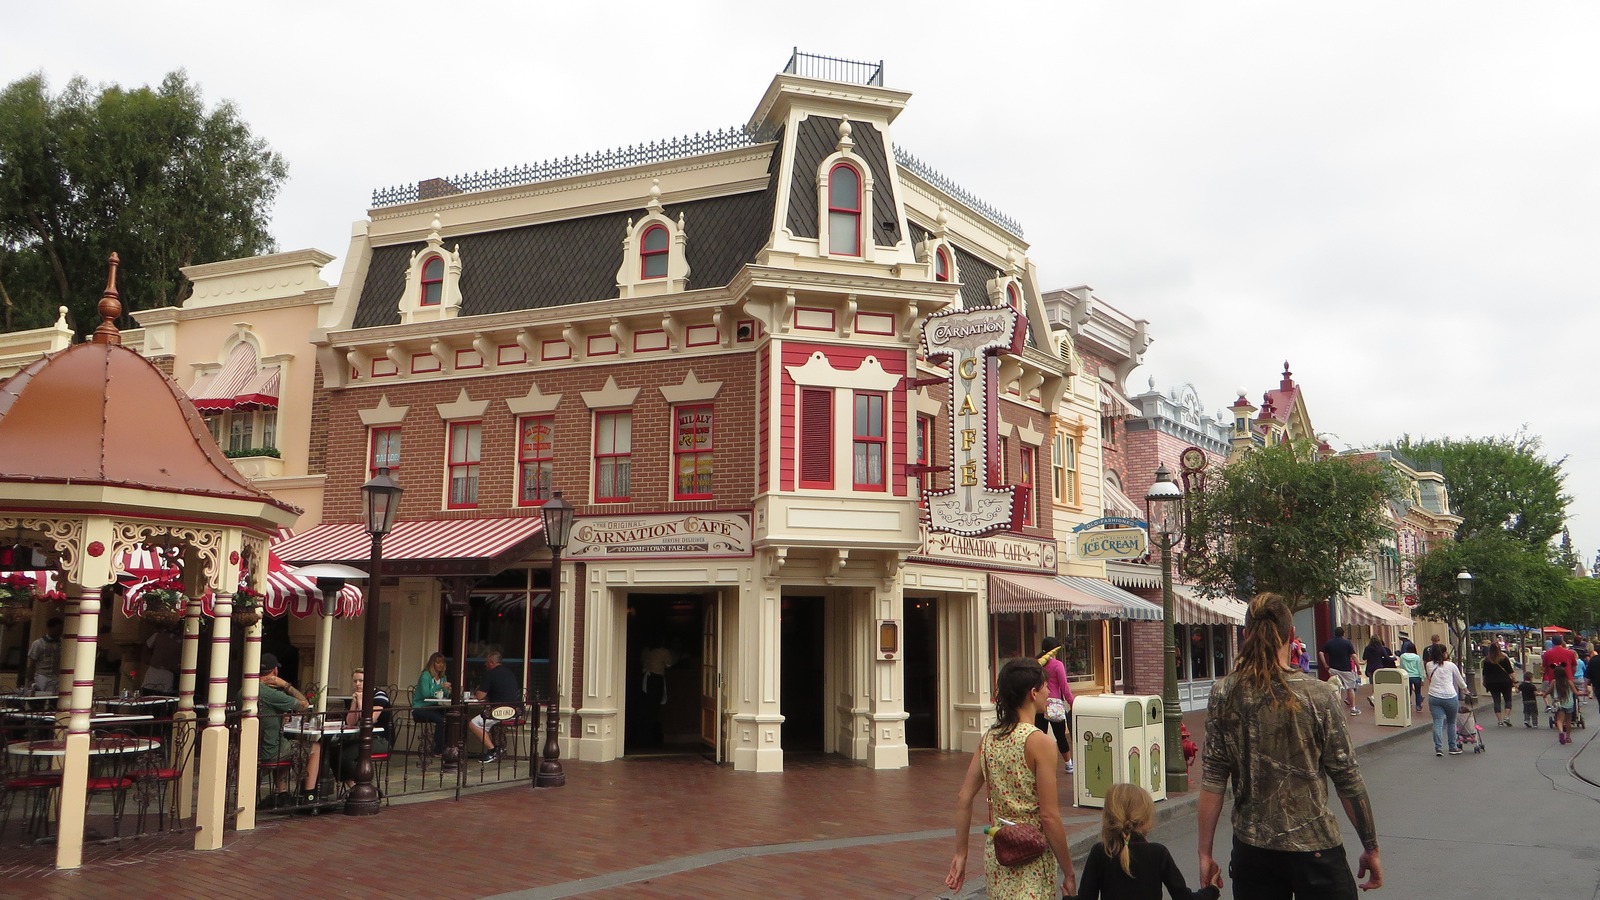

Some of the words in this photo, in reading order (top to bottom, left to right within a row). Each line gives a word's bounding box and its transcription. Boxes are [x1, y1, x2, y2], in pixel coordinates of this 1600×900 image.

[932, 321, 1006, 345] CARNATION
[579, 522, 678, 543] CARNATION
[608, 521, 642, 529] ORIGINAL
[951, 536, 997, 558] CARNATION
[1083, 542, 1100, 556] ICE
[1101, 539, 1139, 555] CREAM
